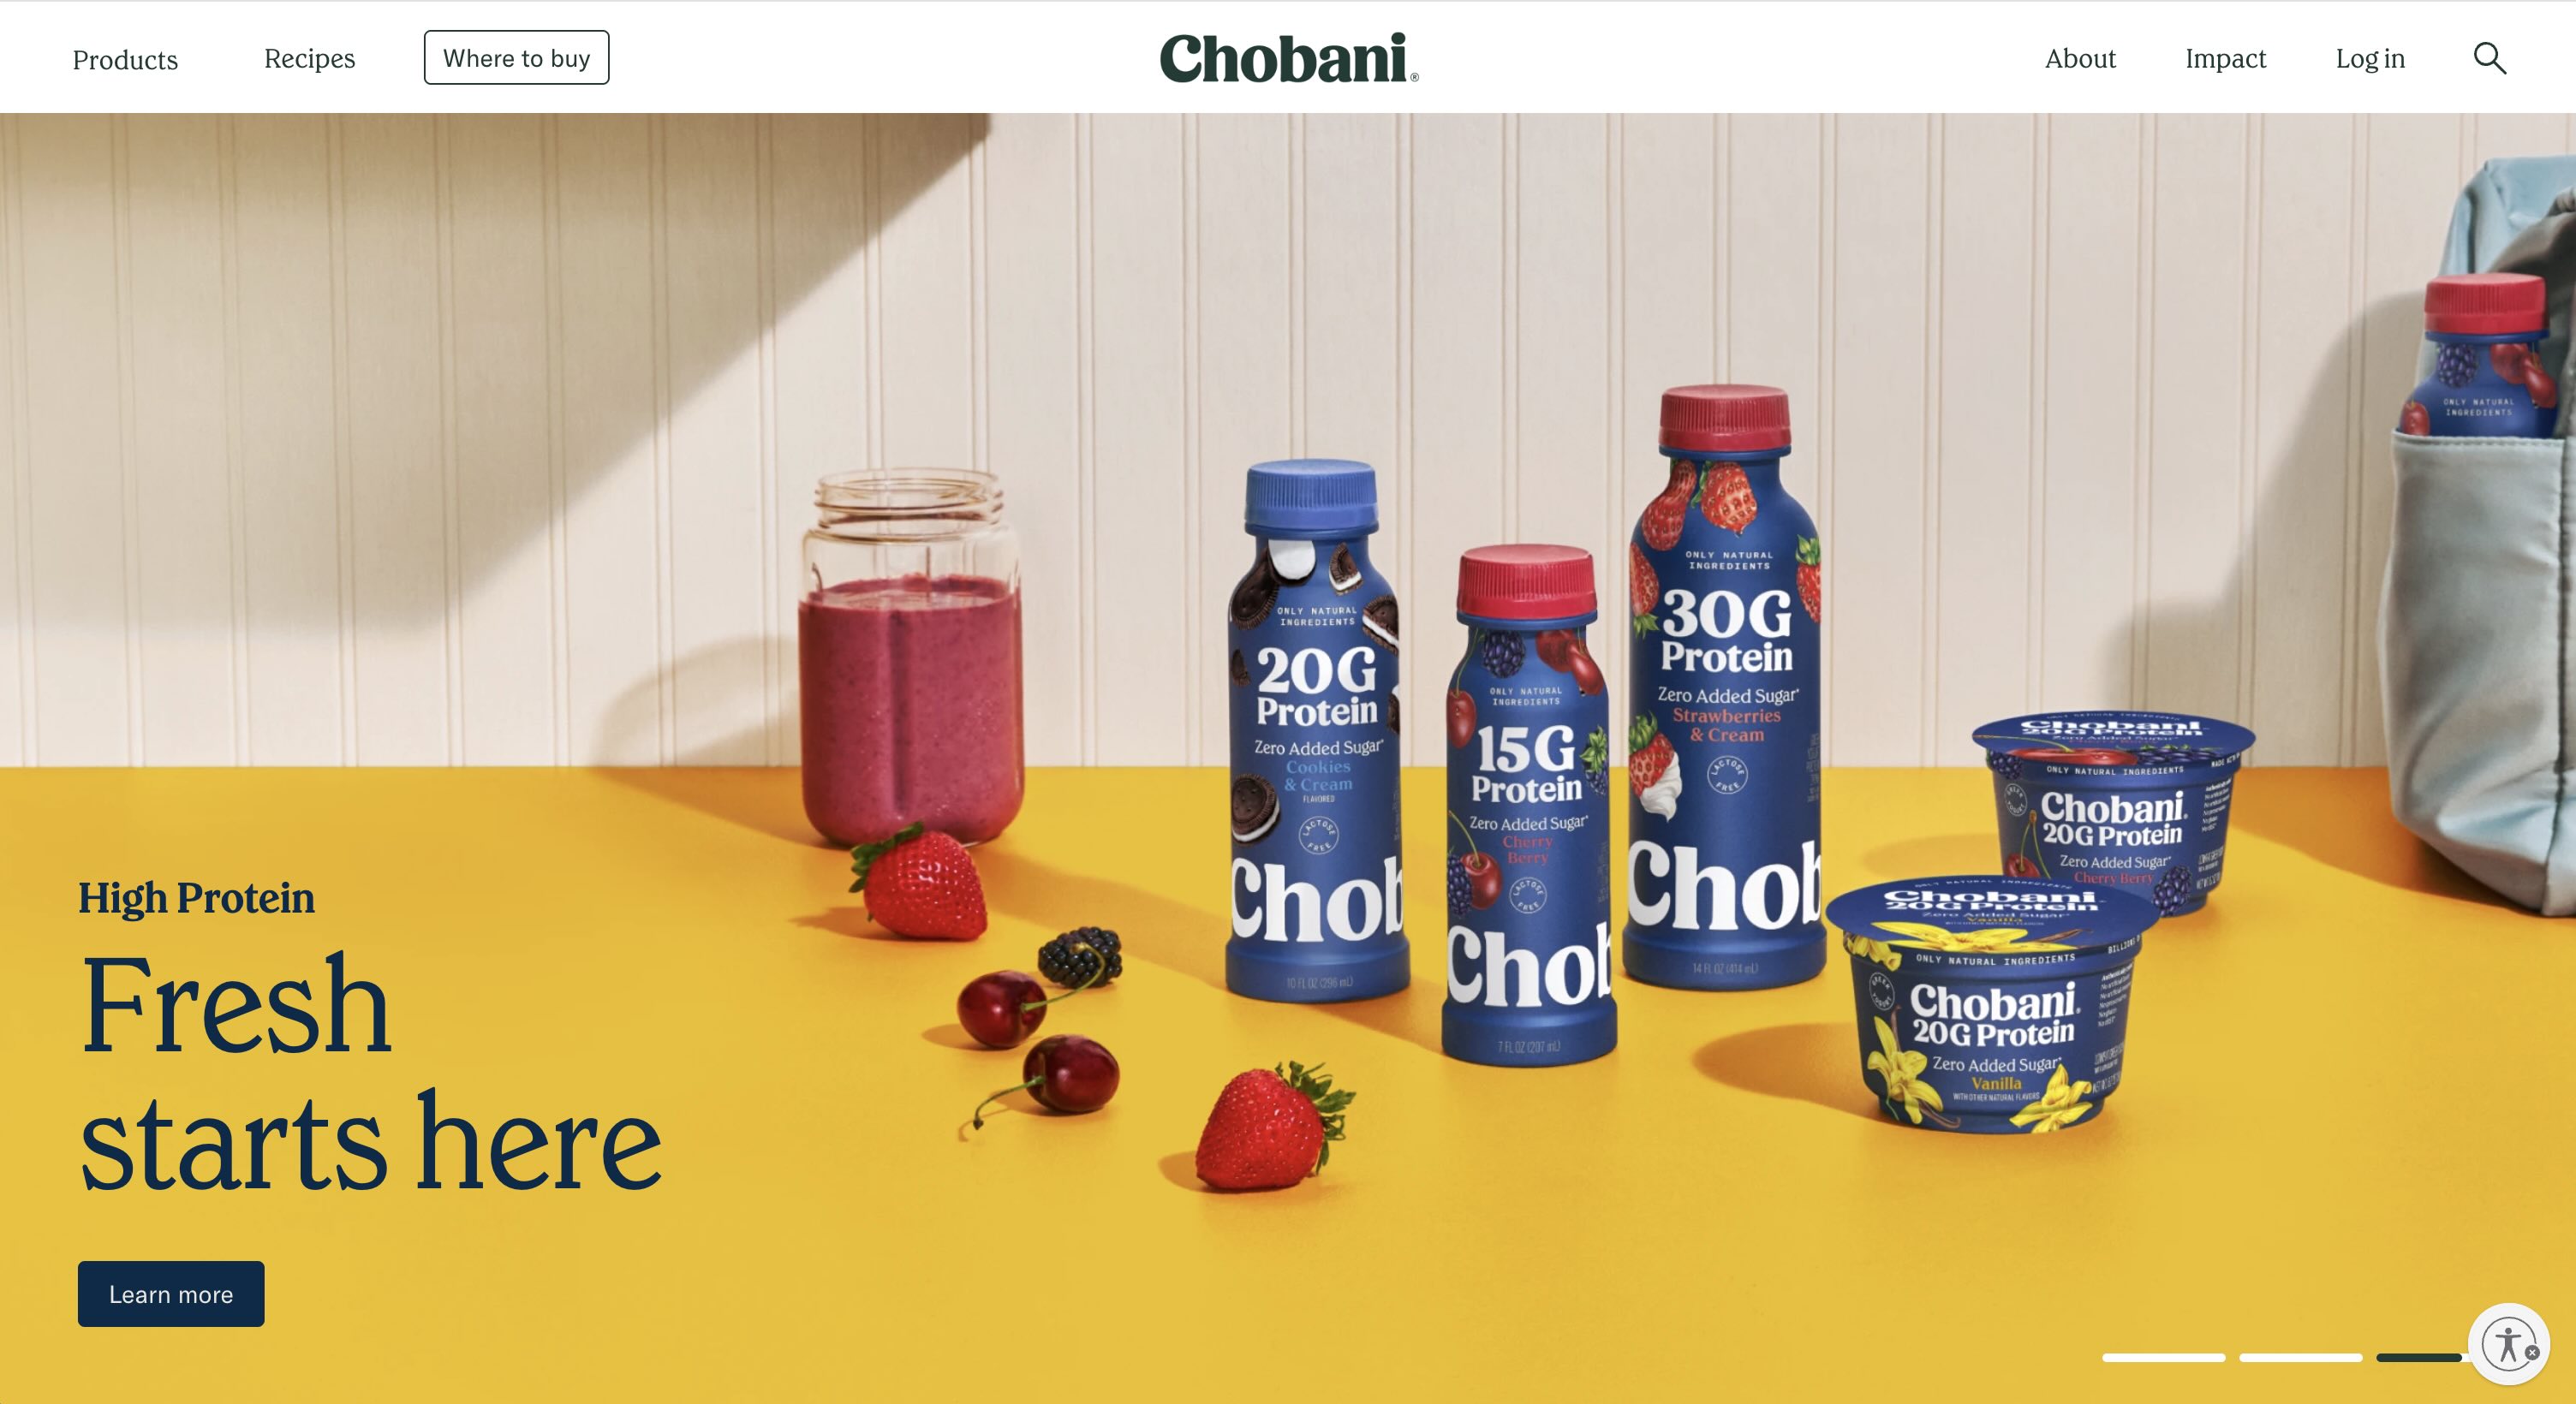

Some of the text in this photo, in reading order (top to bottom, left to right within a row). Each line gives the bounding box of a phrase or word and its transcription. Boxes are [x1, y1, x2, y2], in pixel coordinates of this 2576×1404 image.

[1685, 550, 1773, 559] ONLY NATURAL
[1277, 607, 1303, 616] ONLY
[1663, 589, 1792, 639] 30G
[1280, 617, 1356, 626] INGREDIENTS
[1661, 640, 1793, 673] Protein
[1257, 646, 1377, 695] 20G
[1520, 687, 1562, 695] NATURAL
[1658, 687, 1692, 703] Zero
[1696, 688, 1751, 704] Added
[1494, 698, 1560, 706] INGREDIENTS
[1257, 696, 1379, 727] Protein
[1673, 707, 1781, 723] Strawberries
[2021, 720, 2201, 730] Chobani
[1690, 729, 1764, 742] & Cream
[1255, 740, 1285, 755] Zero
[1289, 741, 1340, 756] Added
[1478, 724, 1576, 773] 15G
[1286, 760, 1351, 774] Cookies
[1711, 759, 1744, 776] LACTOSE
[2075, 767, 2116, 776] NATURAL
[2123, 766, 2184, 776] INGREDIENTS
[1285, 778, 1353, 792] & Cream
[1472, 775, 1583, 804] Protein
[1716, 782, 1740, 792] FREE
[1303, 795, 1335, 804] FLAVORED
[1303, 818, 1336, 837] LACTOSE
[1470, 816, 1498, 830] Zero
[1501, 817, 1547, 831] Added
[2043, 822, 2183, 847] 20G Protein
[1307, 842, 1332, 852] FREE
[1503, 836, 1553, 848] Cherry
[1507, 852, 1548, 866] Berry
[2060, 854, 2088, 868] Zero
[2090, 856, 2132, 869] Added
[2074, 872, 2155, 885] Cherry Berry
[1512, 879, 1543, 896] LACTOSE
[1884, 890, 2096, 903] Chobani
[1518, 901, 1539, 911] FREE
[1886, 901, 2099, 911] 20G Protein
[1917, 954, 2075, 966] ONLY NATURAL INGREDIENTS
[1914, 1020, 1972, 1045] 20G
[1977, 1020, 2075, 1047] Protein
[1933, 1056, 1965, 1072] Zero
[1968, 1058, 2016, 1073] Added
[1971, 1076, 2023, 1091] Vanilla
[1953, 1092, 2040, 1102] WITH OTHER NATURAL FLAVORS
